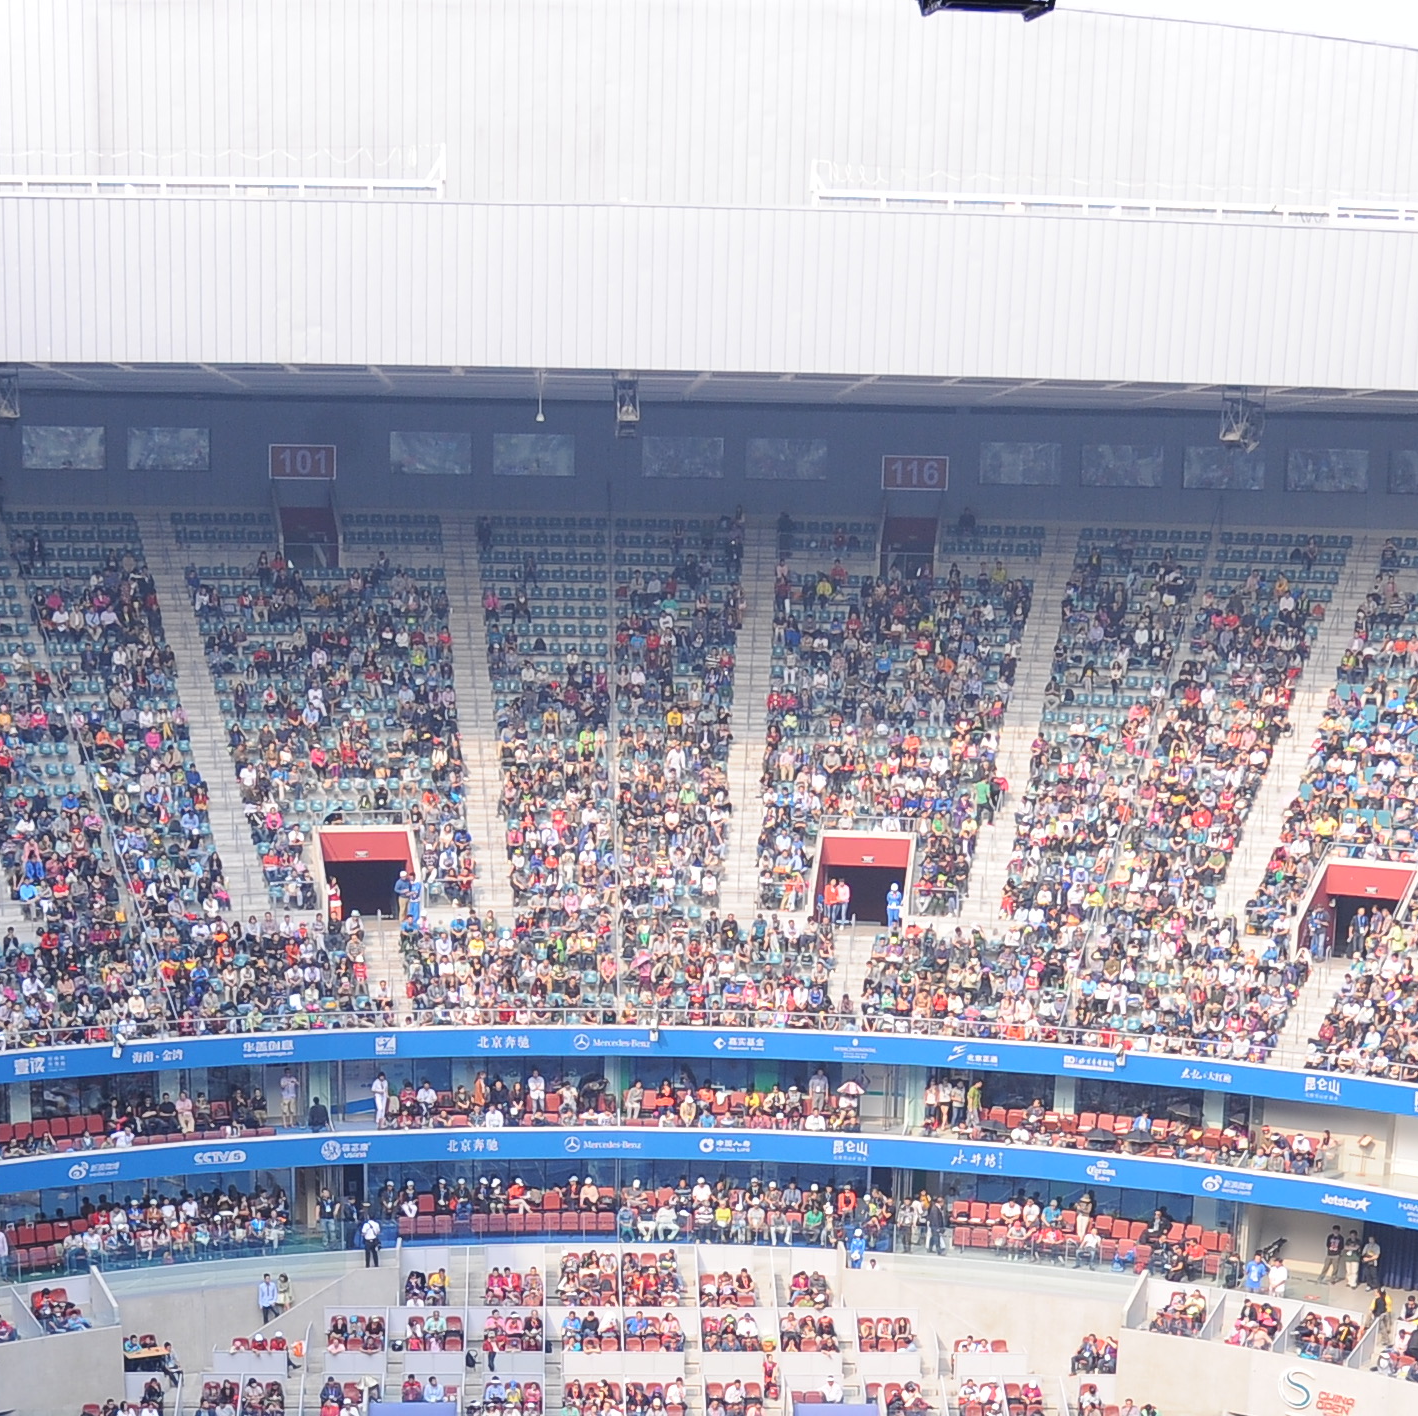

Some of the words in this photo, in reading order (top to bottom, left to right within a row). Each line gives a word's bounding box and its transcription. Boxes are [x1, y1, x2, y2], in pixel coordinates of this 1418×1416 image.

[281, 449, 326, 474] 101
[891, 460, 939, 485] 116
[477, 1035, 530, 1049] 北京奔驰
[593, 1038, 651, 1048] Mercedes-Benz
[1305, 1077, 1340, 1096] 昆仑山
[447, 1138, 499, 1152] 北京奔驰
[583, 1140, 641, 1149] Mercedes-Benz
[833, 1140, 869, 1156] 昆仑山
[1321, 1194, 1359, 1209] Jetstar
